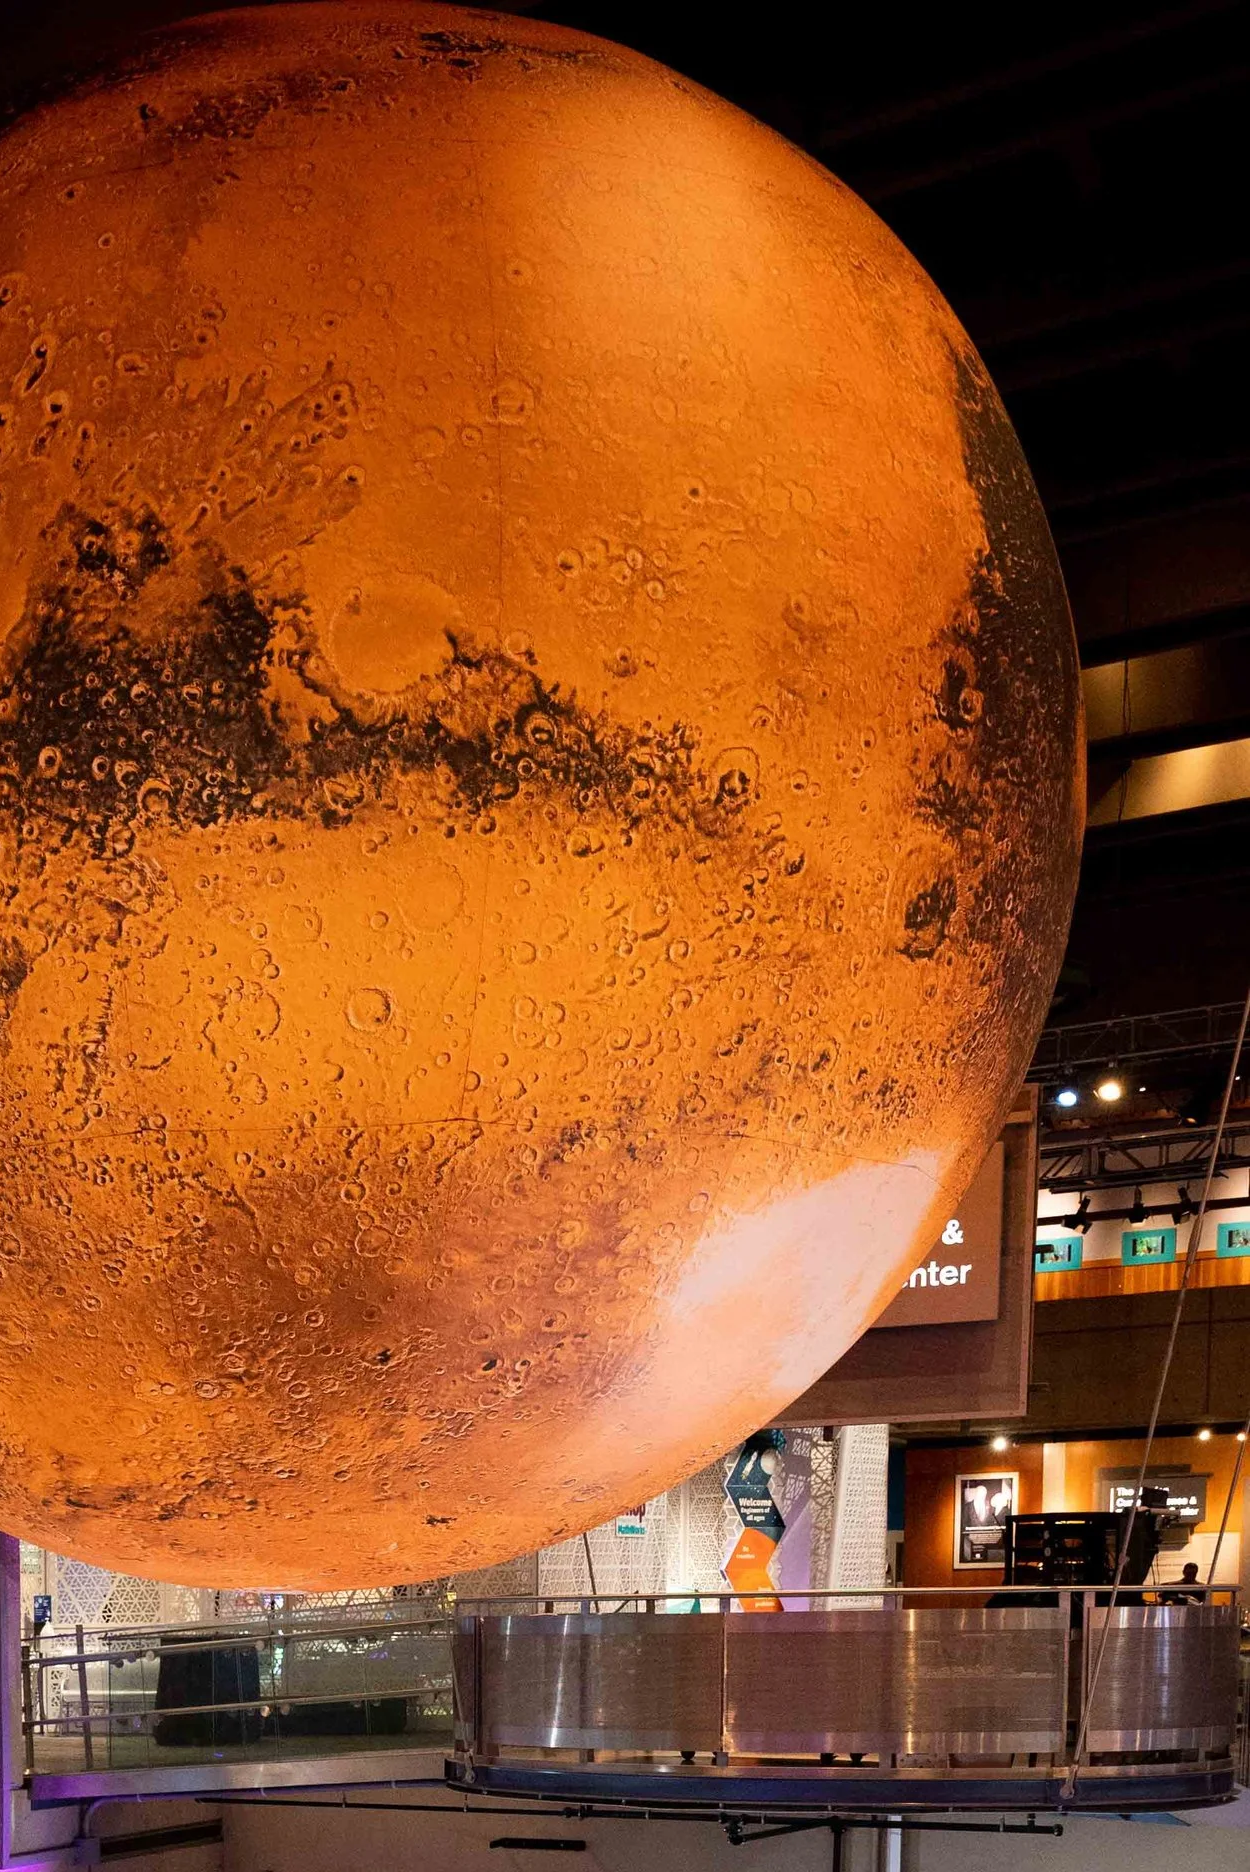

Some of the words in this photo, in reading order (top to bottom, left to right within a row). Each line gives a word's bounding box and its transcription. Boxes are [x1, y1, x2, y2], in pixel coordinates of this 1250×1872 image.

[941, 1219, 964, 1245] &
[902, 1261, 972, 1288] nter
[739, 1498, 772, 1507] Welcome
